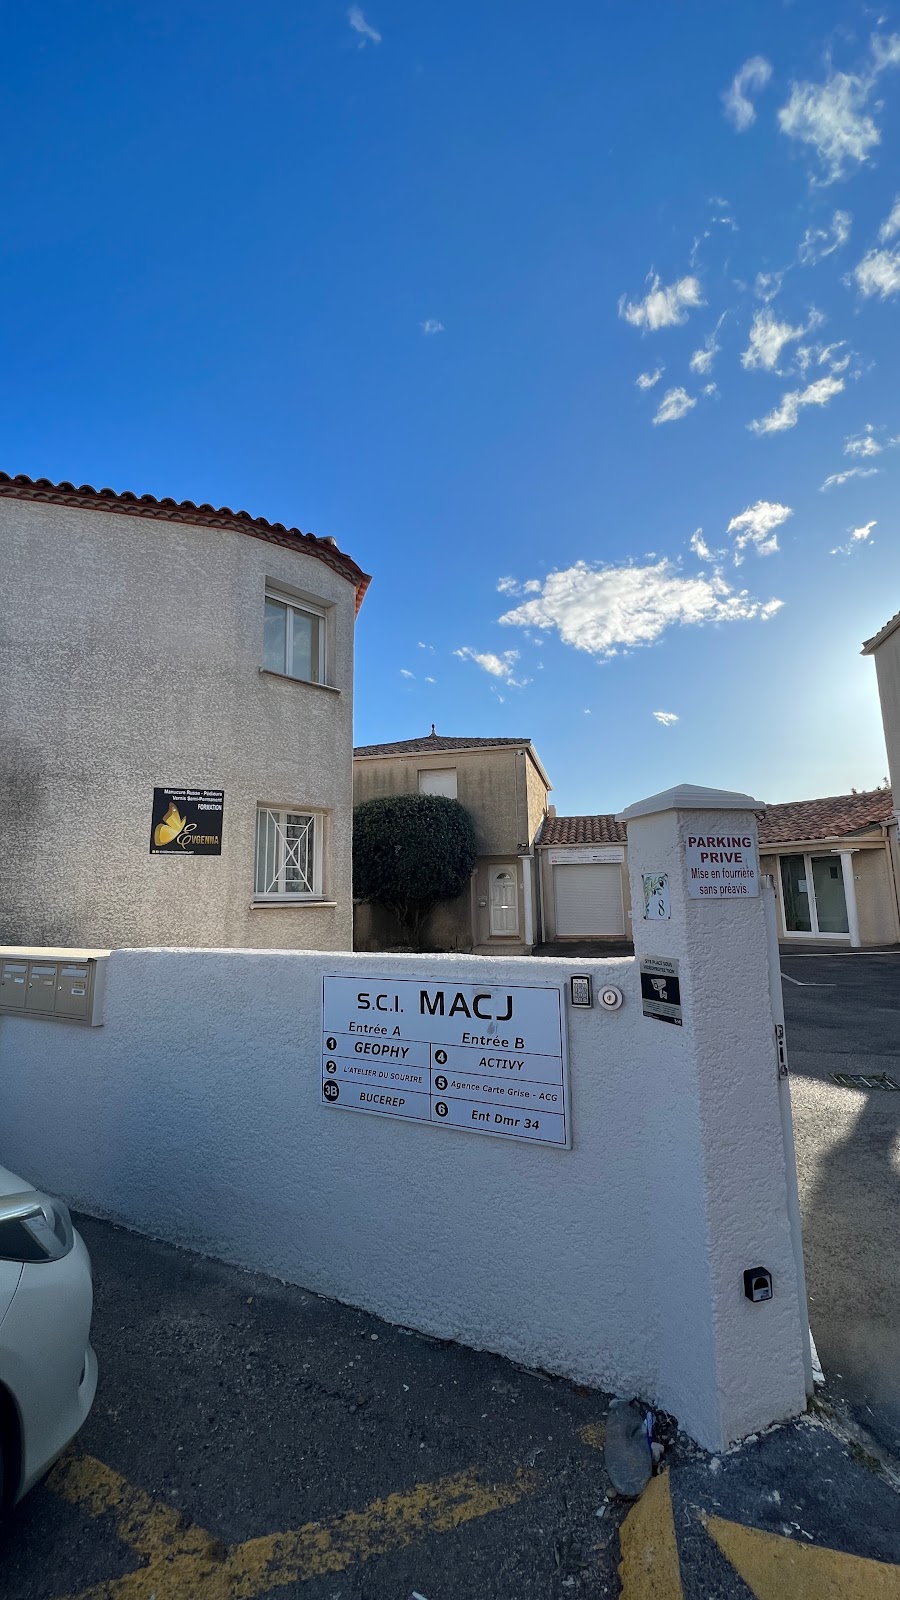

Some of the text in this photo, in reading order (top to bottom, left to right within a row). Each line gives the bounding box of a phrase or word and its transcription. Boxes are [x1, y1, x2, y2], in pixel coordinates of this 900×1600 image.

[688, 836, 752, 848] PARKING
[700, 852, 742, 863] PRIVE
[691, 868, 709, 879] Mise
[711, 870, 720, 879] en
[700, 886, 718, 894] sans
[658, 900, 666, 916] 8
[357, 990, 513, 1021] S.C.I. MACJ
[348, 1022, 401, 1036] Entrée A
[462, 1032, 525, 1048] Entrée B
[354, 1042, 410, 1058] GEOPHY
[478, 1058, 525, 1070] ACTIVY
[343, 1066, 377, 1077] L'ATELIER
[390, 1074, 423, 1084] SOURIRE
[325, 1085, 406, 1108] 3B BUCEREP
[450, 1080, 480, 1091] Agence
[482, 1084, 505, 1094] Carte
[508, 1088, 530, 1098] Grise
[538, 1092, 558, 1102] ACG
[472, 1110, 490, 1122] Ent
[494, 1114, 521, 1127] Dmr
[524, 1118, 540, 1130] 34
